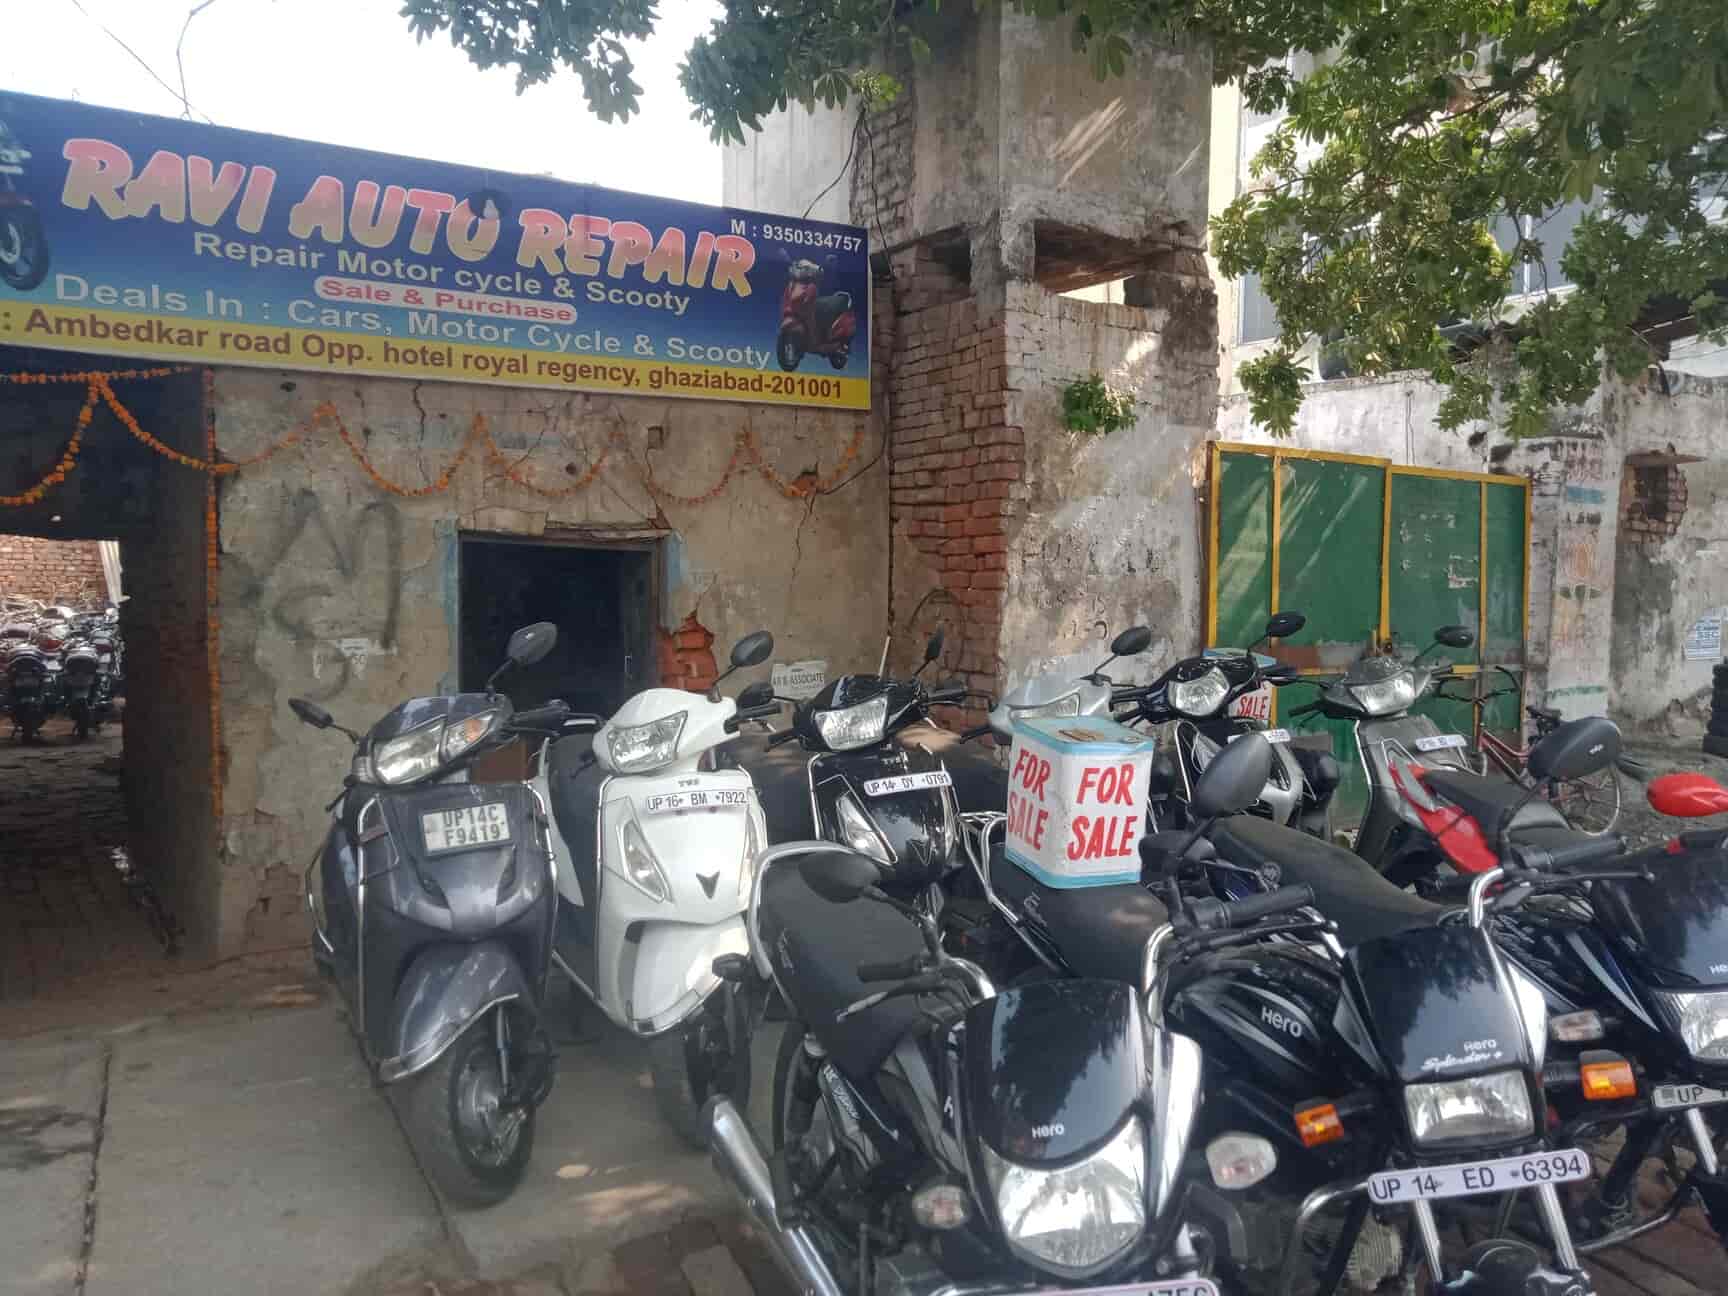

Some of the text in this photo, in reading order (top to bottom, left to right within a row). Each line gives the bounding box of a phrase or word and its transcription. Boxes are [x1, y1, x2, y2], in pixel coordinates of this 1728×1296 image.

[62, 138, 756, 297] RAVI AUTO REPAIR
[730, 219, 747, 237] M
[763, 226, 862, 253] 9350334757
[194, 231, 690, 316] Repair Motor cycle & Scooty
[321, 279, 572, 321] Sale & Purchase
[55, 273, 188, 312] Deals
[205, 289, 244, 319] In
[408, 310, 517, 344] Motor
[527, 323, 621, 353] Cycle
[632, 336, 656, 358] &
[667, 337, 772, 371] Scooty
[24, 307, 209, 348] Ambedkar
[219, 331, 291, 355] road
[302, 333, 372, 365] Opp.
[383, 340, 453, 368] hotel
[462, 352, 529, 377] royal
[536, 359, 641, 387] regency,
[648, 366, 842, 399] ghaziabad-201001
[1237, 695, 1269, 719] SALE
[1012, 747, 1051, 802] FOR
[1076, 763, 1136, 806] FOR
[647, 791, 747, 810] UP 16 BM 7922
[1007, 791, 1049, 850] SALE
[1066, 815, 1138, 861] SALE
[1261, 1004, 1303, 1038] Hero
[1463, 1039, 1497, 1053] Hero
[1676, 1086, 1703, 1103] UP
[1031, 1121, 1065, 1139] Hero
[1371, 1154, 1583, 1200] UP 14 ED 6394
